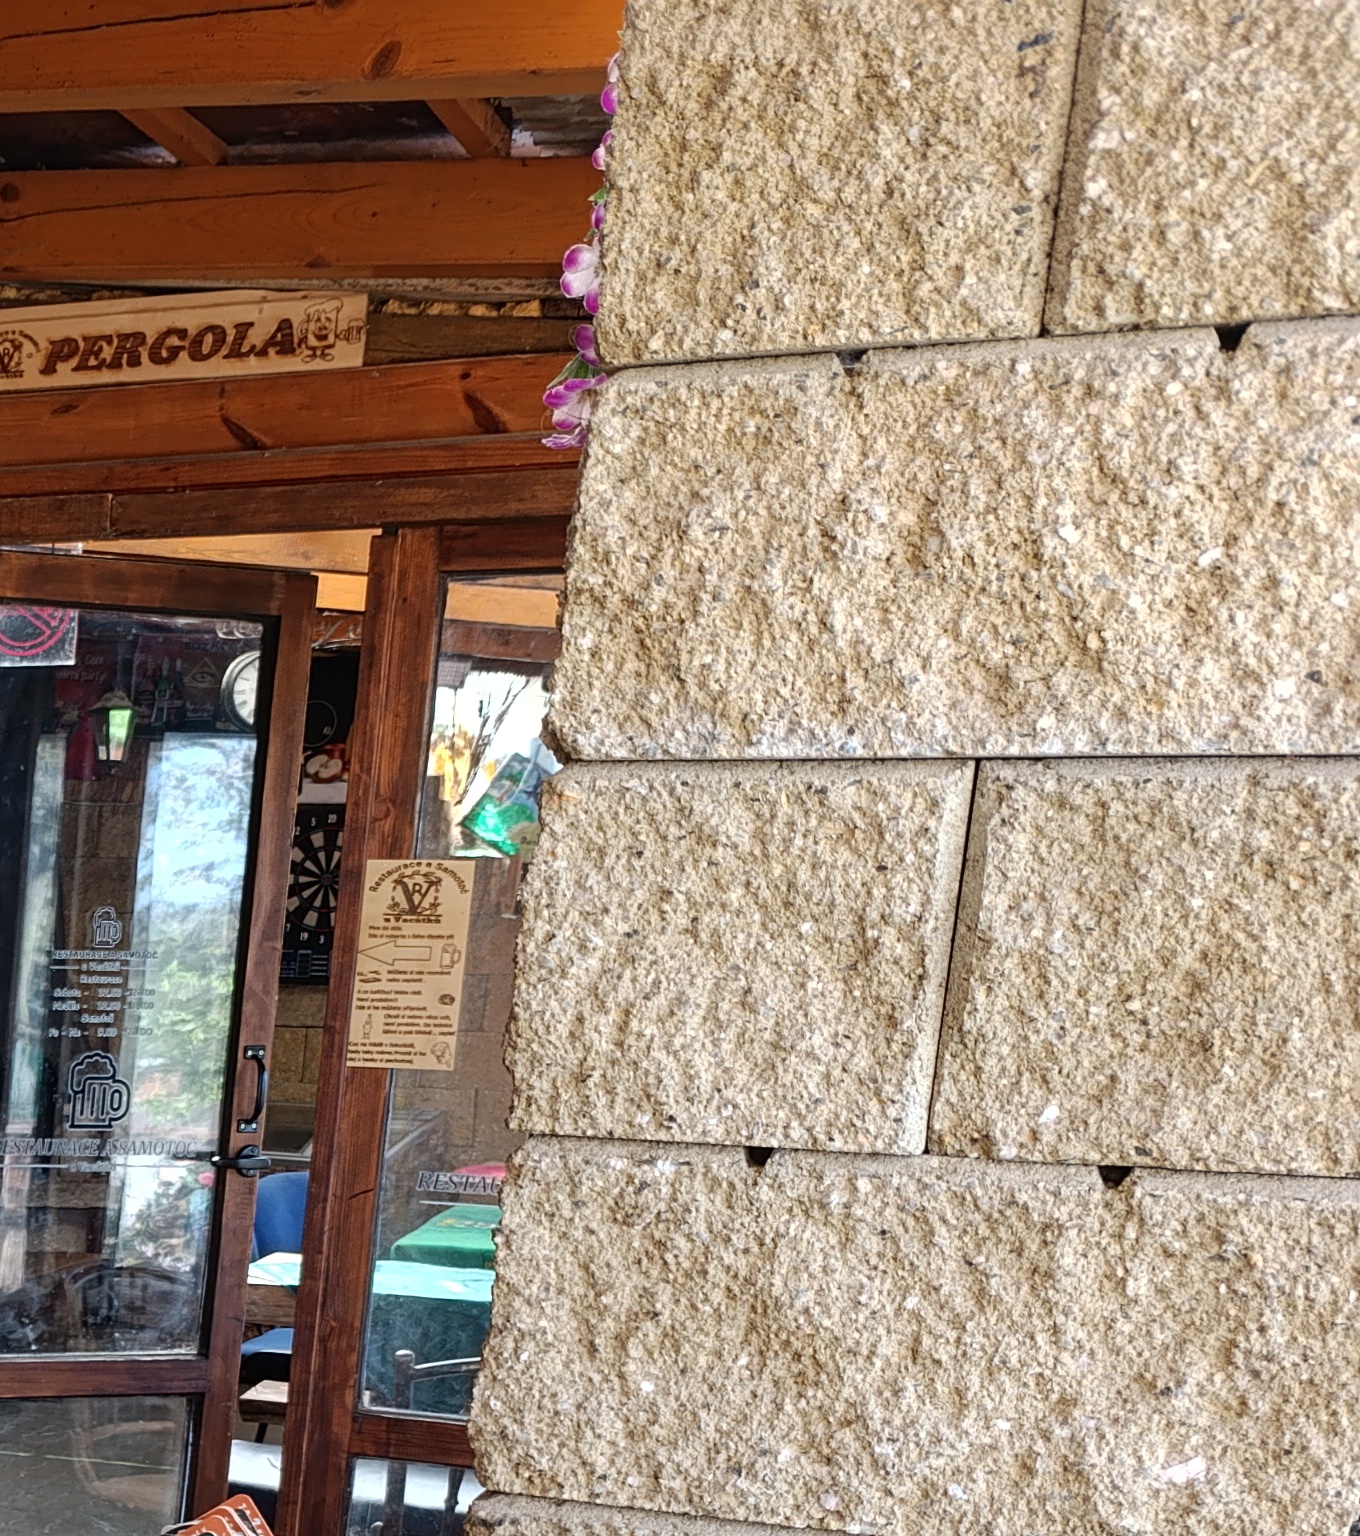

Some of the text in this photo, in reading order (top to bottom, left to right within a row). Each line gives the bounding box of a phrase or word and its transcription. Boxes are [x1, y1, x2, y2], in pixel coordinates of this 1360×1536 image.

[39, 318, 298, 376] PERGOLA
[368, 861, 422, 893] Restaurace
[299, 931, 308, 941] 19
